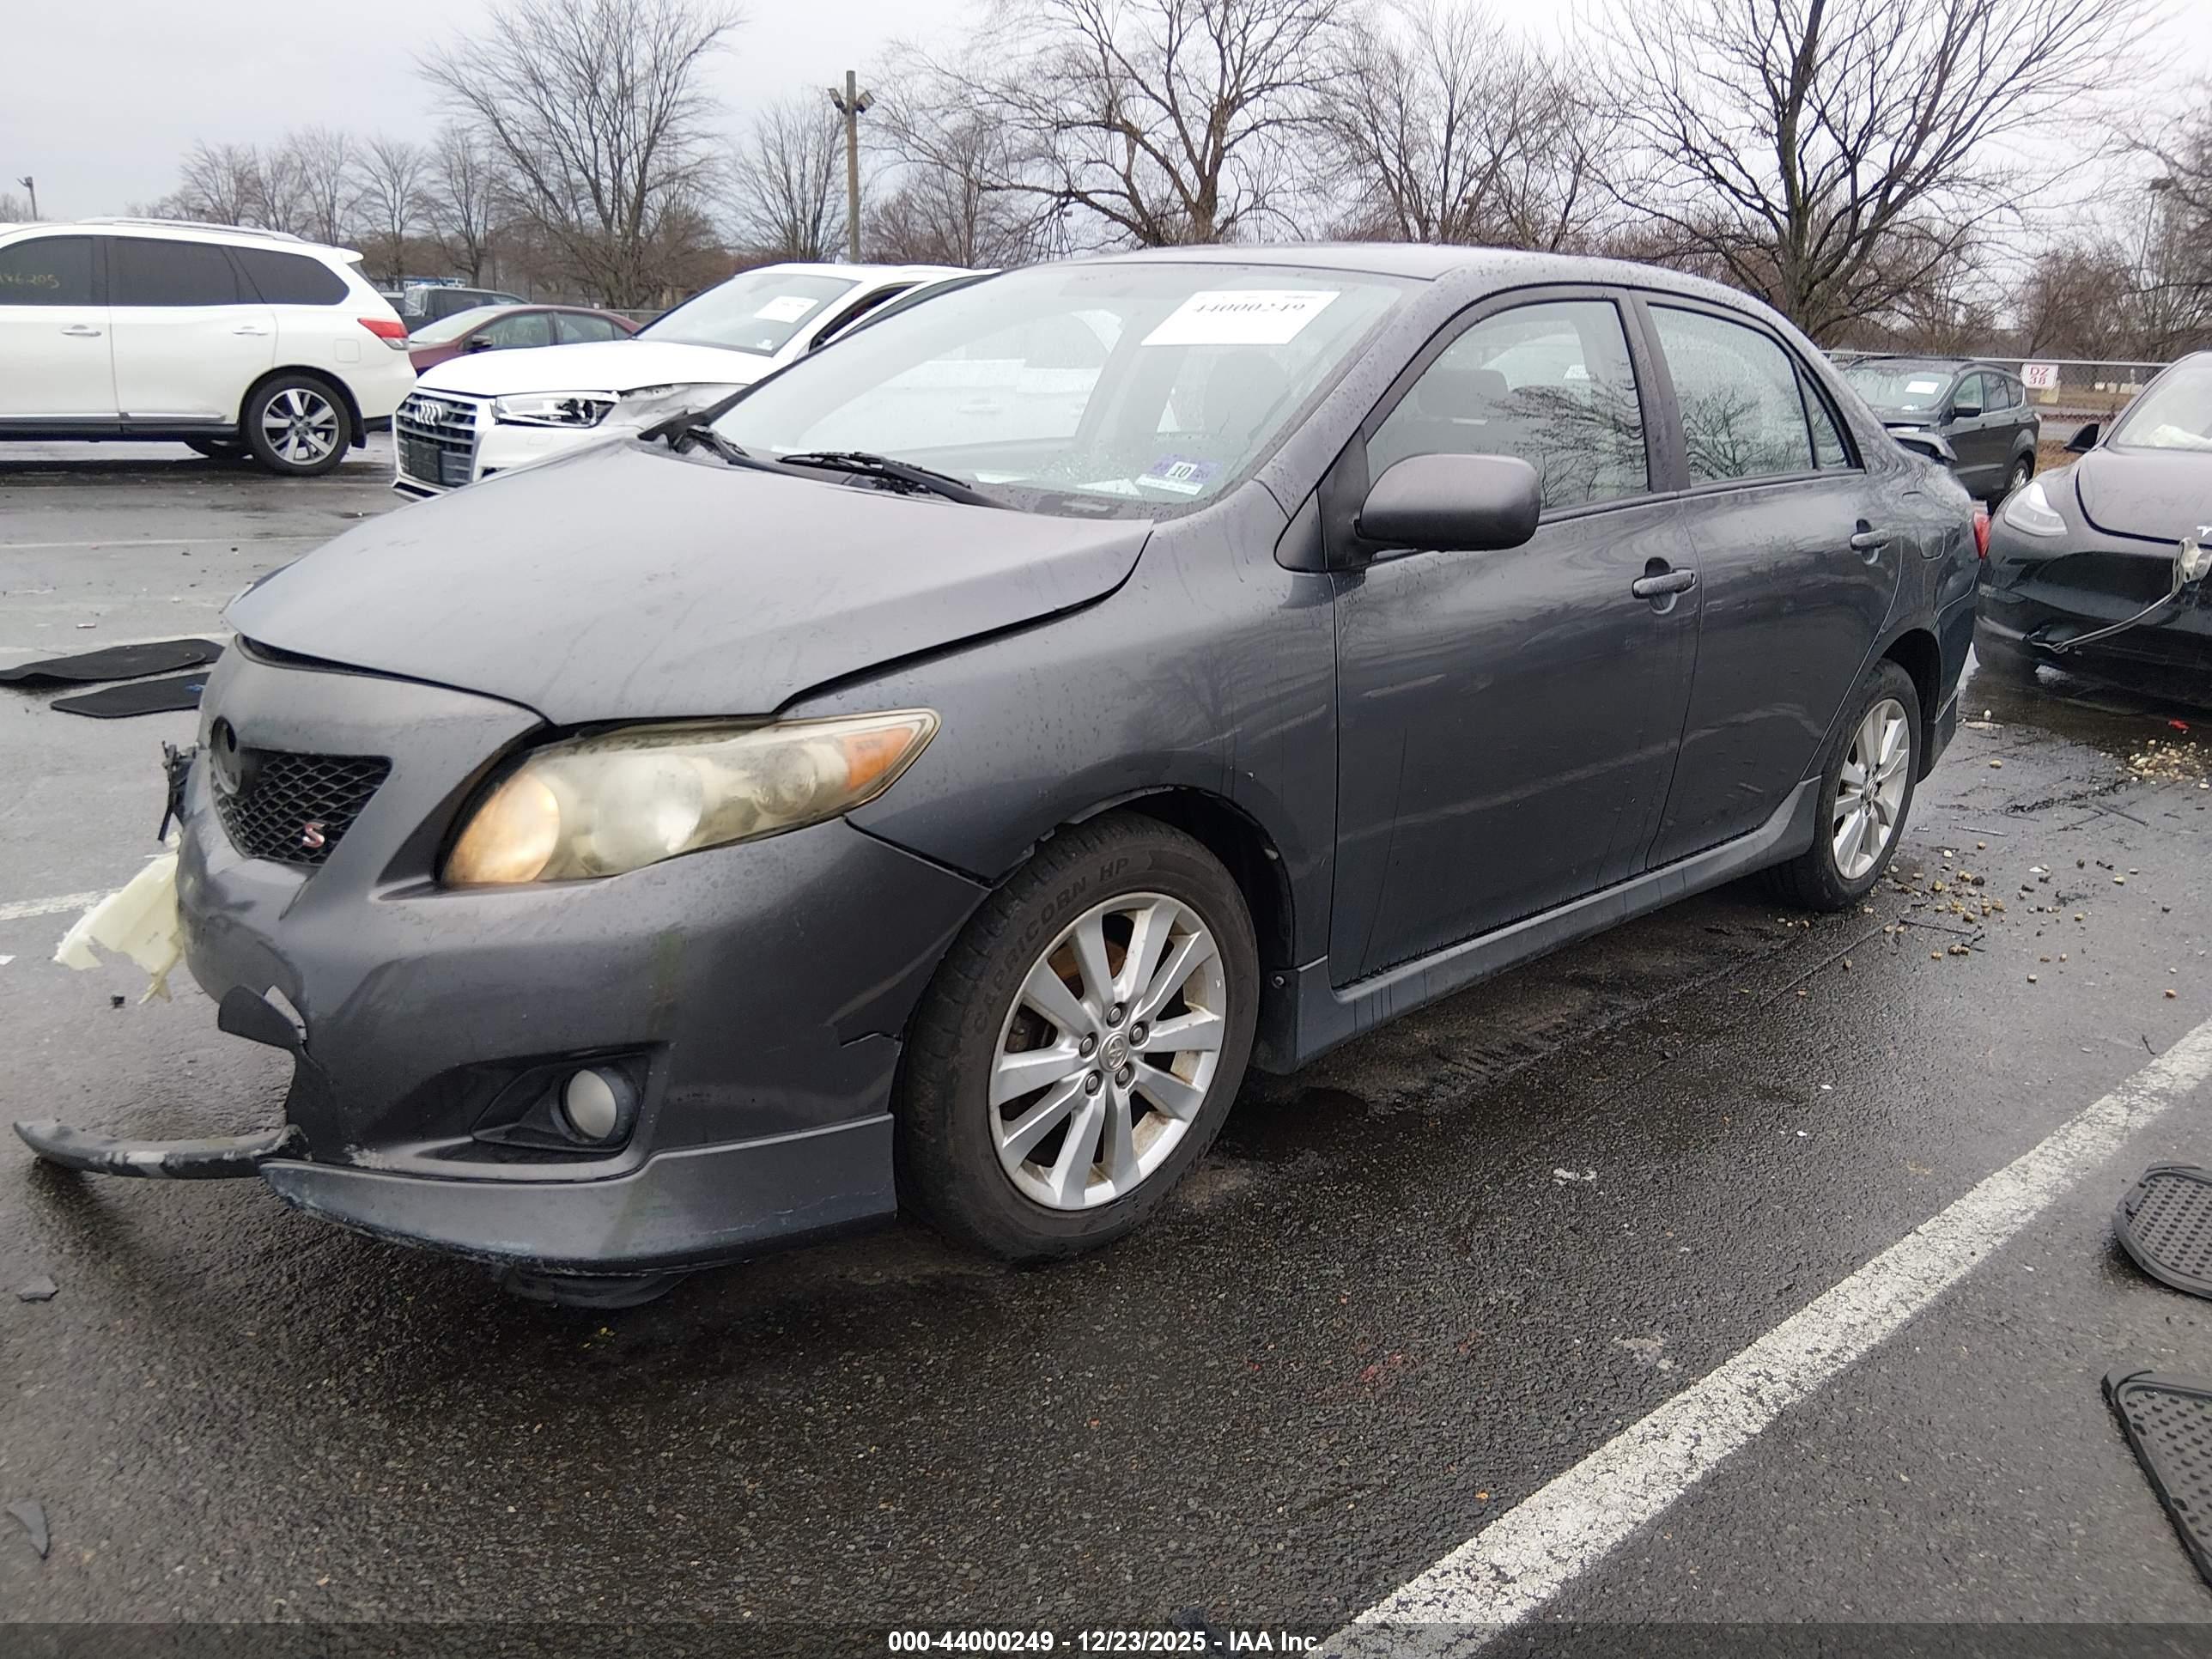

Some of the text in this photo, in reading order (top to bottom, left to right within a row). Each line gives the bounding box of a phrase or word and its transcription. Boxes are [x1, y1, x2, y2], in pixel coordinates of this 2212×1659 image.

[1170, 465, 1192, 478] 10
[301, 821, 325, 848] S
[1098, 857, 1130, 883] HP
